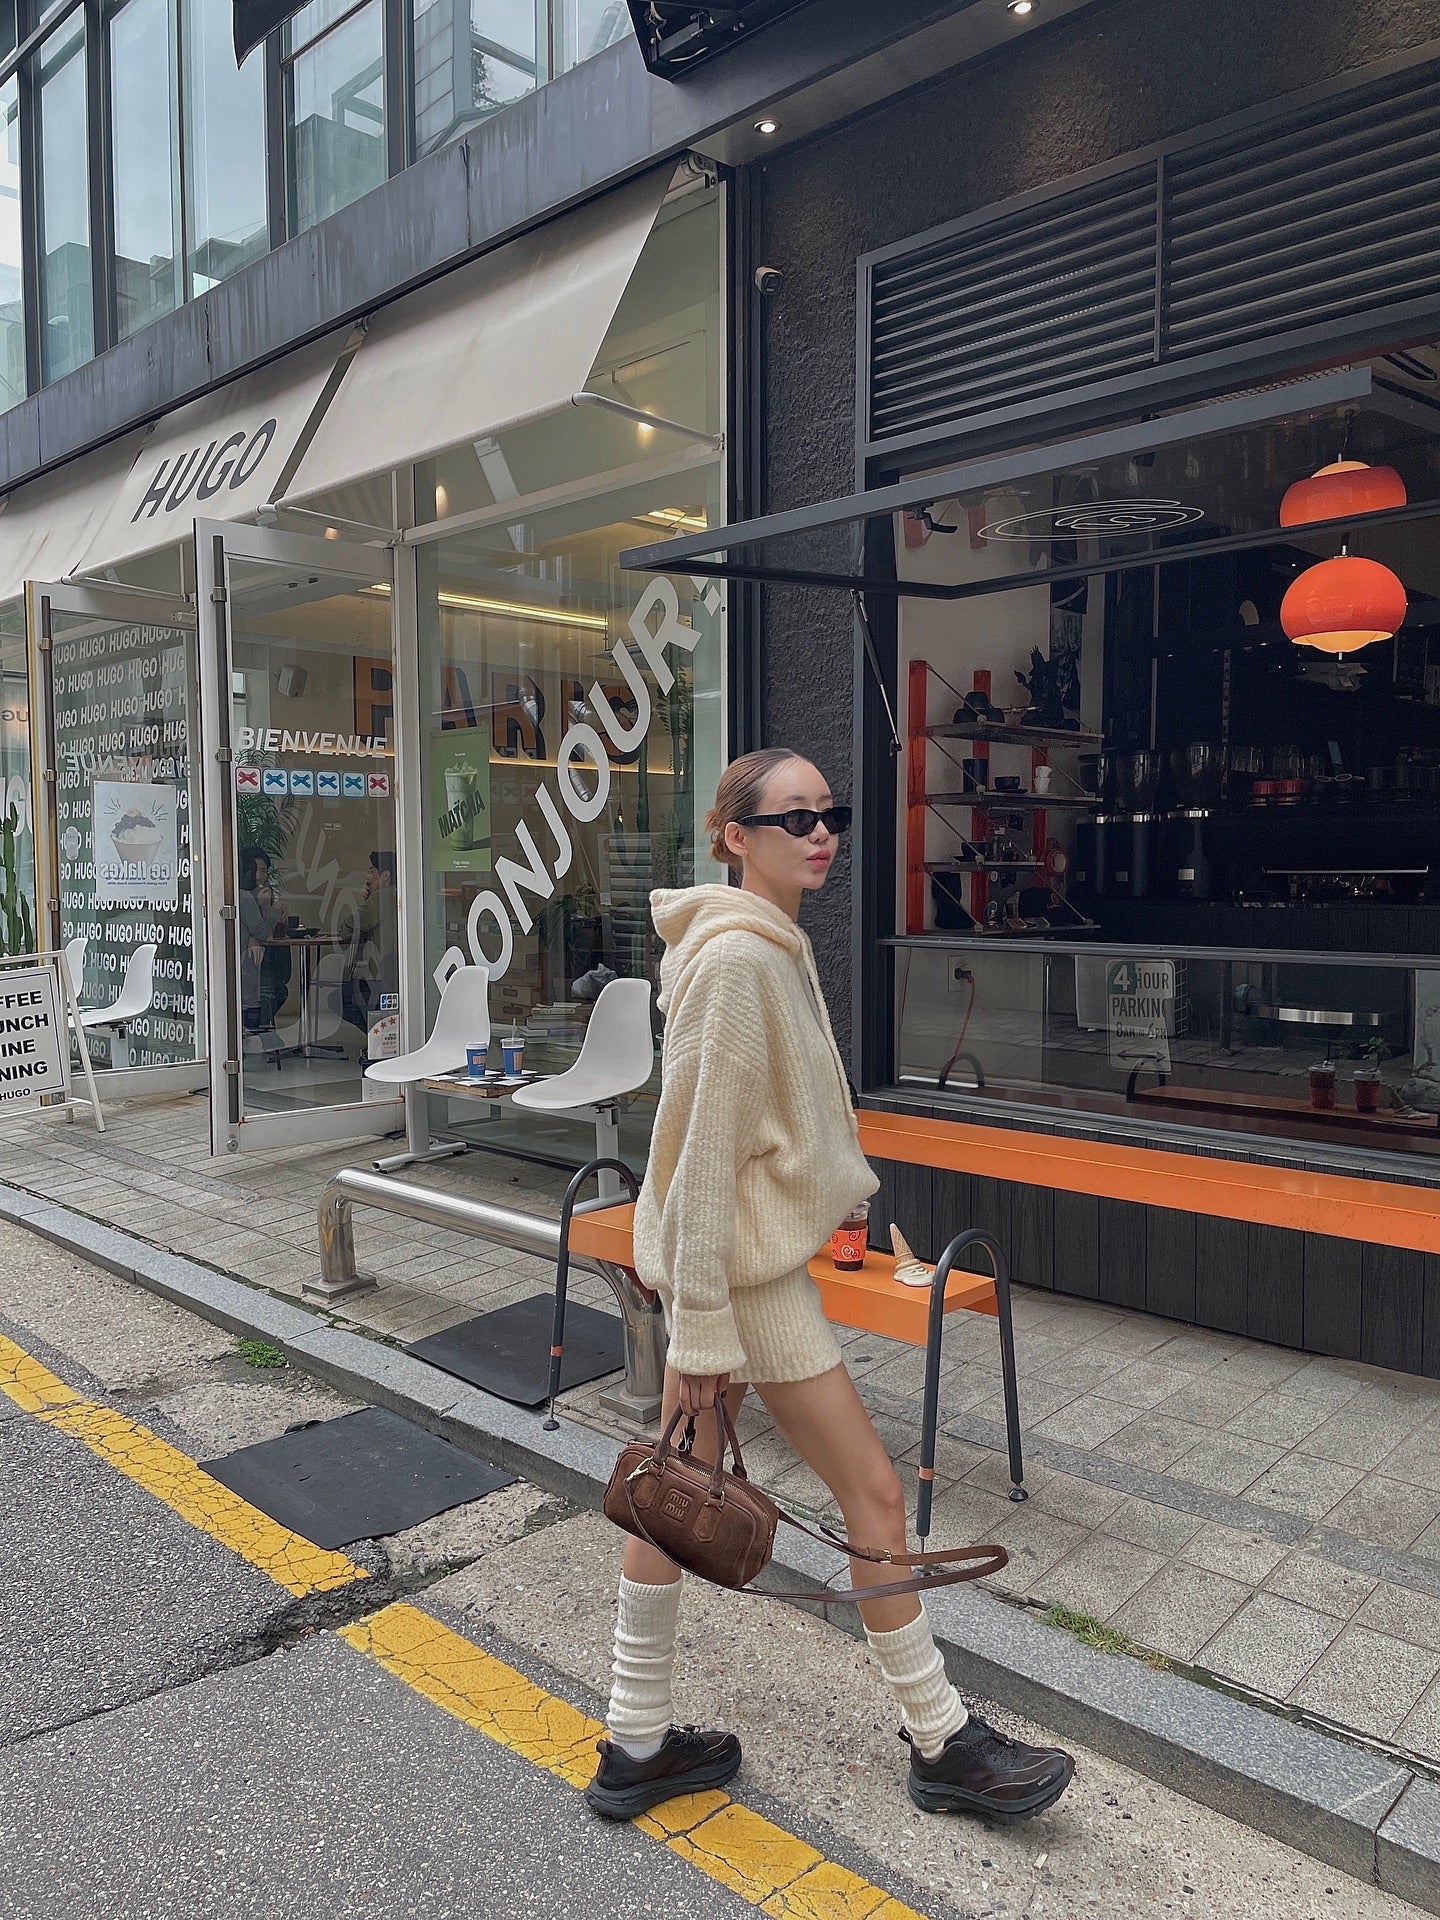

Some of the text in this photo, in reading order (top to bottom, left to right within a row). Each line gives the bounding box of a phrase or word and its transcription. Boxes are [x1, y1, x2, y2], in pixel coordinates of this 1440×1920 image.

[130, 418, 277, 524] HUGO
[54, 646, 75, 665] HUGO
[80, 637, 105, 659] HUGO
[110, 630, 137, 652] HUGO
[68, 670, 93, 693] HUGO
[97, 664, 124, 687] HUGO
[129, 656, 157, 681] HUGO
[55, 709, 77, 729] HUGO
[81, 703, 106, 724] HUGO
[110, 696, 138, 719] HUGO
[143, 688, 173, 712] HUGO
[70, 736, 94, 755] HUGO
[99, 732, 125, 753] HUGO
[130, 724, 158, 748] HUGO
[238, 727, 388, 759] BIENVENUE
[57, 771, 79, 789] HUGO
[62, 892, 84, 909] HUGO
[77, 922, 102, 941] HUGO
[106, 923, 133, 943] HUGO
[135, 922, 164, 943] HUGO
[90, 953, 116, 972] HUGO
[152, 958, 182, 980] HUGO
[1113, 964, 1169, 991] 4 HOUR
[0, 990, 43, 1009] FEE
[0, 1013, 49, 1034] NCH
[154, 1021, 183, 1043] HUGO
